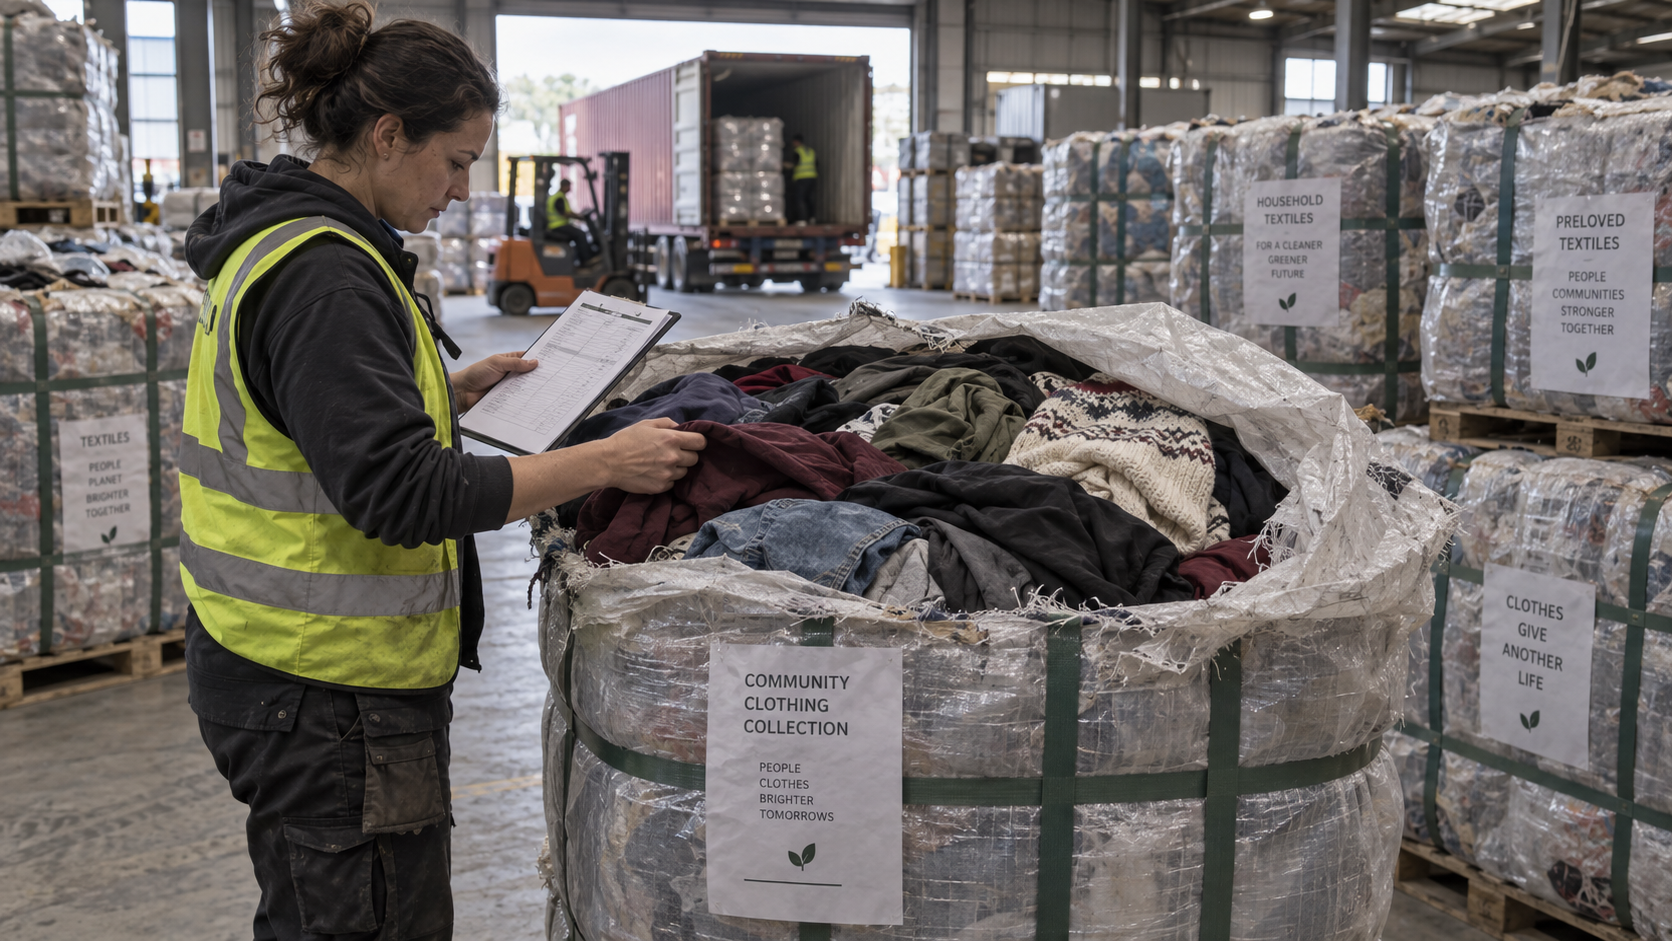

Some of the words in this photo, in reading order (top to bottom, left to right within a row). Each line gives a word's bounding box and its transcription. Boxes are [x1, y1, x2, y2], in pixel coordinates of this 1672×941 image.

[1257, 194, 1324, 208] HOUSEHOLD
[1264, 212, 1314, 225] TEXTILES
[1556, 213, 1625, 229] PRELOVED
[1256, 241, 1272, 250] FOR
[1274, 241, 1281, 250] A
[1282, 240, 1323, 250] CLEANER
[1559, 236, 1620, 250] TEXTILES
[1268, 254, 1308, 265] GREENER
[1271, 269, 1305, 279] FUTURE
[1568, 271, 1606, 282] PEOPLE
[1552, 288, 1625, 300] COMMUNITIES
[1561, 305, 1615, 318] STRONGER
[1561, 322, 1614, 335] TOGETHER
[80, 431, 130, 448] TEXTILES
[89, 459, 122, 472] PEOPLE
[88, 474, 122, 487] PLANET
[86, 489, 129, 504] BRIGHTER
[85, 503, 131, 518] TOGETHER
[1506, 595, 1564, 621] CLOTHES
[1518, 622, 1548, 642] GIVE
[1502, 643, 1563, 672] ANOTHER
[744, 673, 850, 690] COMMUNITY
[1518, 670, 1544, 691] LIFE
[744, 696, 829, 712] CLOTHING
[743, 719, 848, 736] COLLECTION
[759, 762, 801, 773] PEOPLE
[759, 778, 809, 790] CLOTHES
[759, 793, 814, 806] BRIGHTER
[759, 809, 834, 822] TOMORROWS
